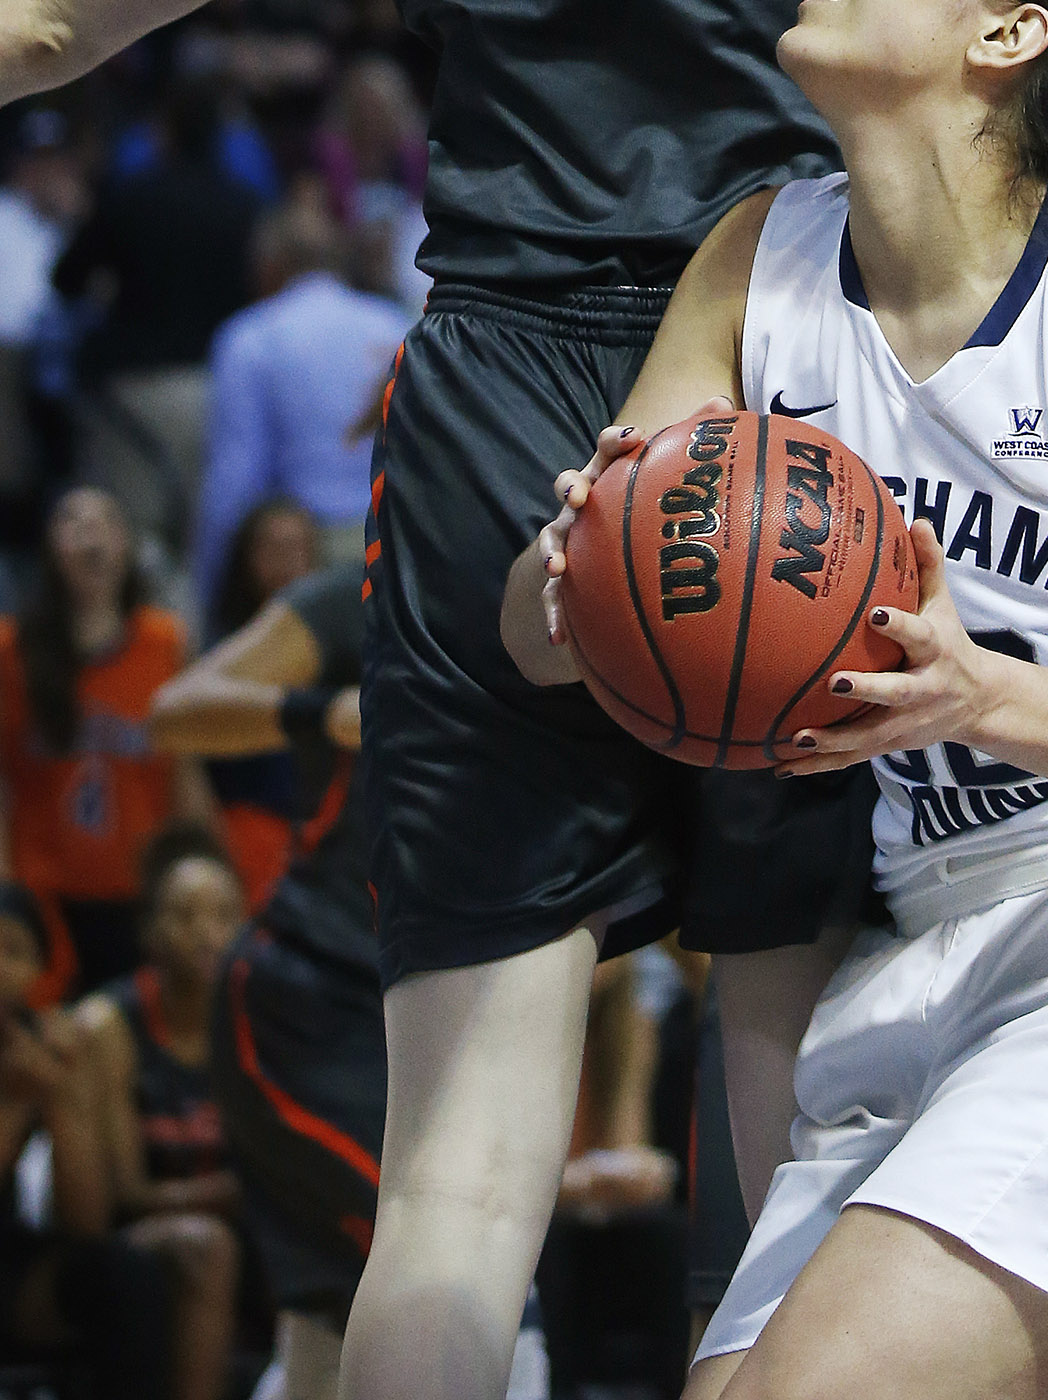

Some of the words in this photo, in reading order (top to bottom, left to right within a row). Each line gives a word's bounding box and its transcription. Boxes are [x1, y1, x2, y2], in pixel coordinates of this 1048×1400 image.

[994, 441, 1023, 450] WEST
[657, 417, 739, 622] Wilson
[771, 439, 834, 600] NCAA
[821, 530, 842, 598] OFFICIAL
